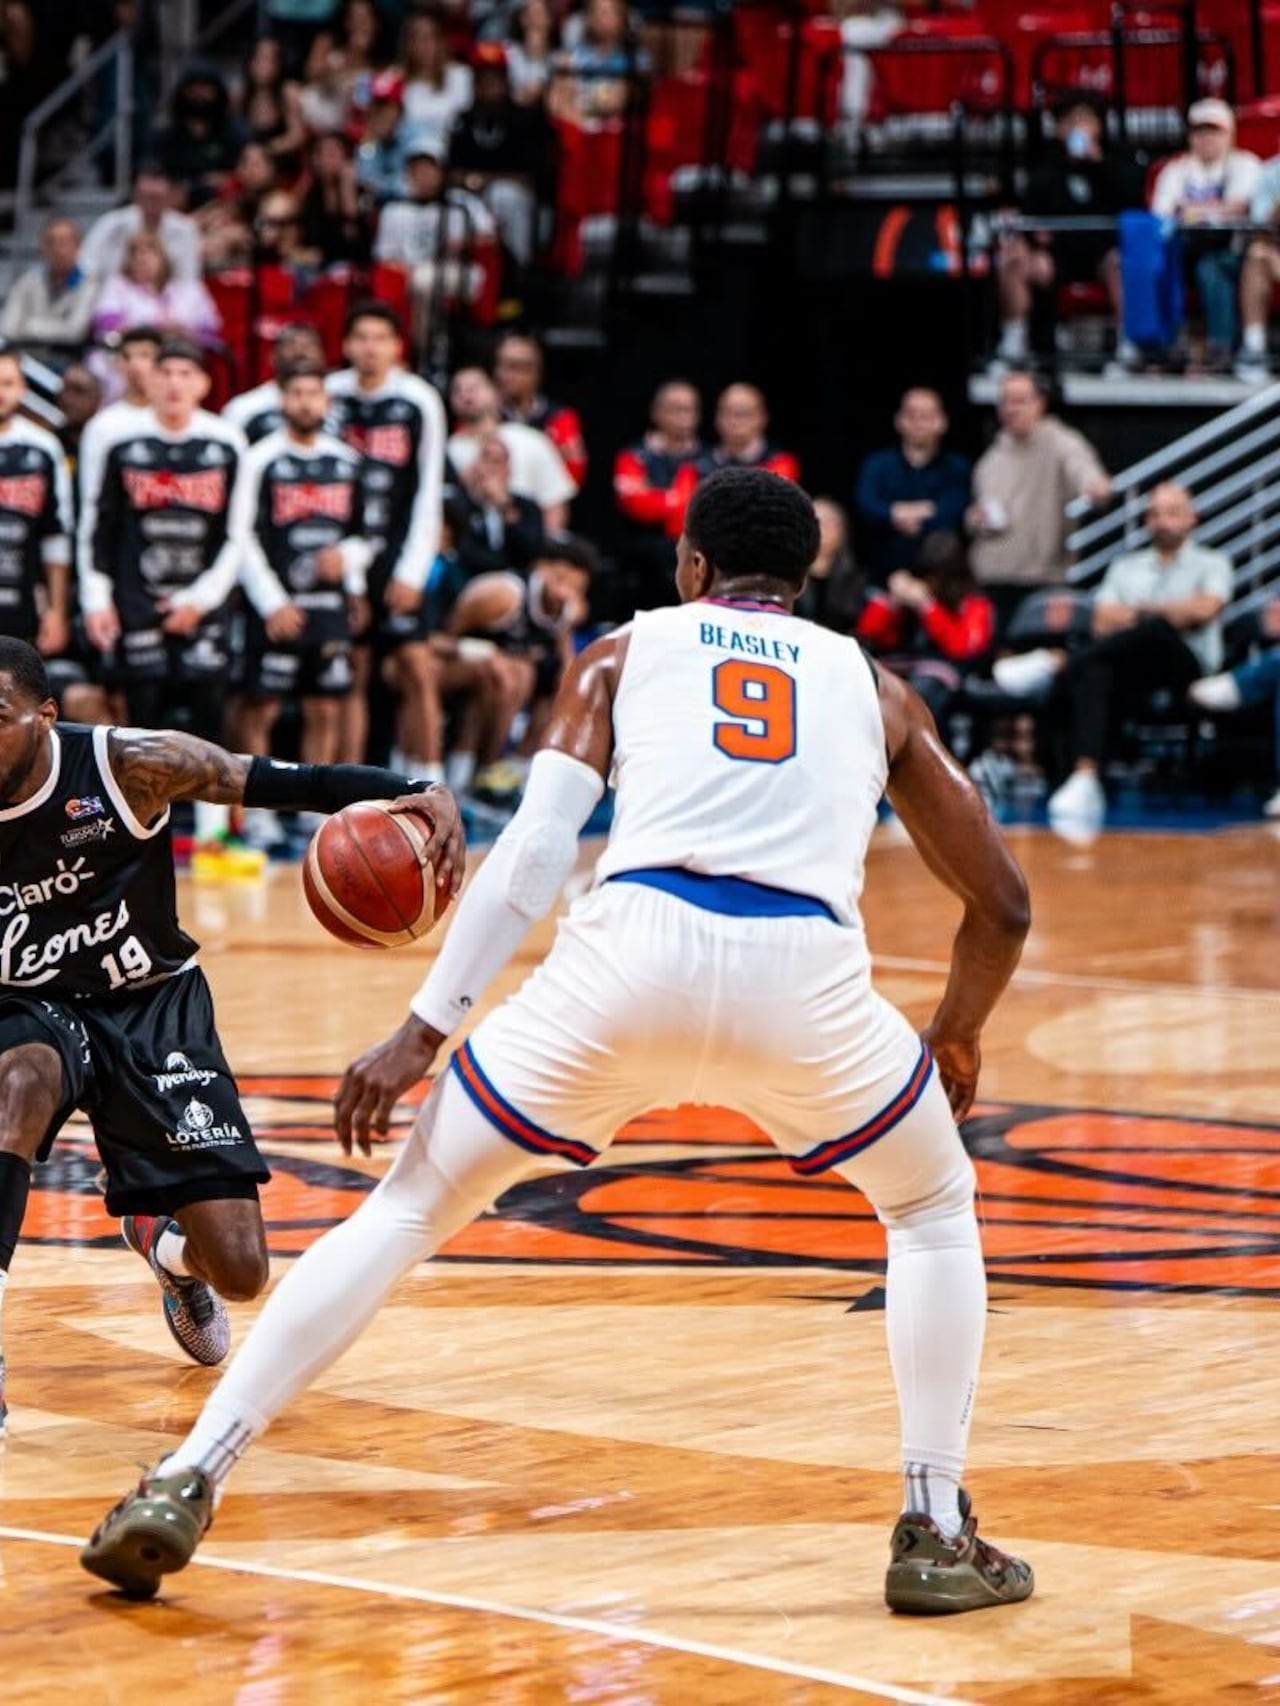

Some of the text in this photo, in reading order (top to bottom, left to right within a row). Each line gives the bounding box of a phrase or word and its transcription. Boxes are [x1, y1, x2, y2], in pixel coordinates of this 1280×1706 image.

[699, 622, 800, 664] BEASLEY
[712, 658, 797, 765] 9
[100, 935, 153, 990] 19
[165, 1122, 242, 1145] LOTERÍA
